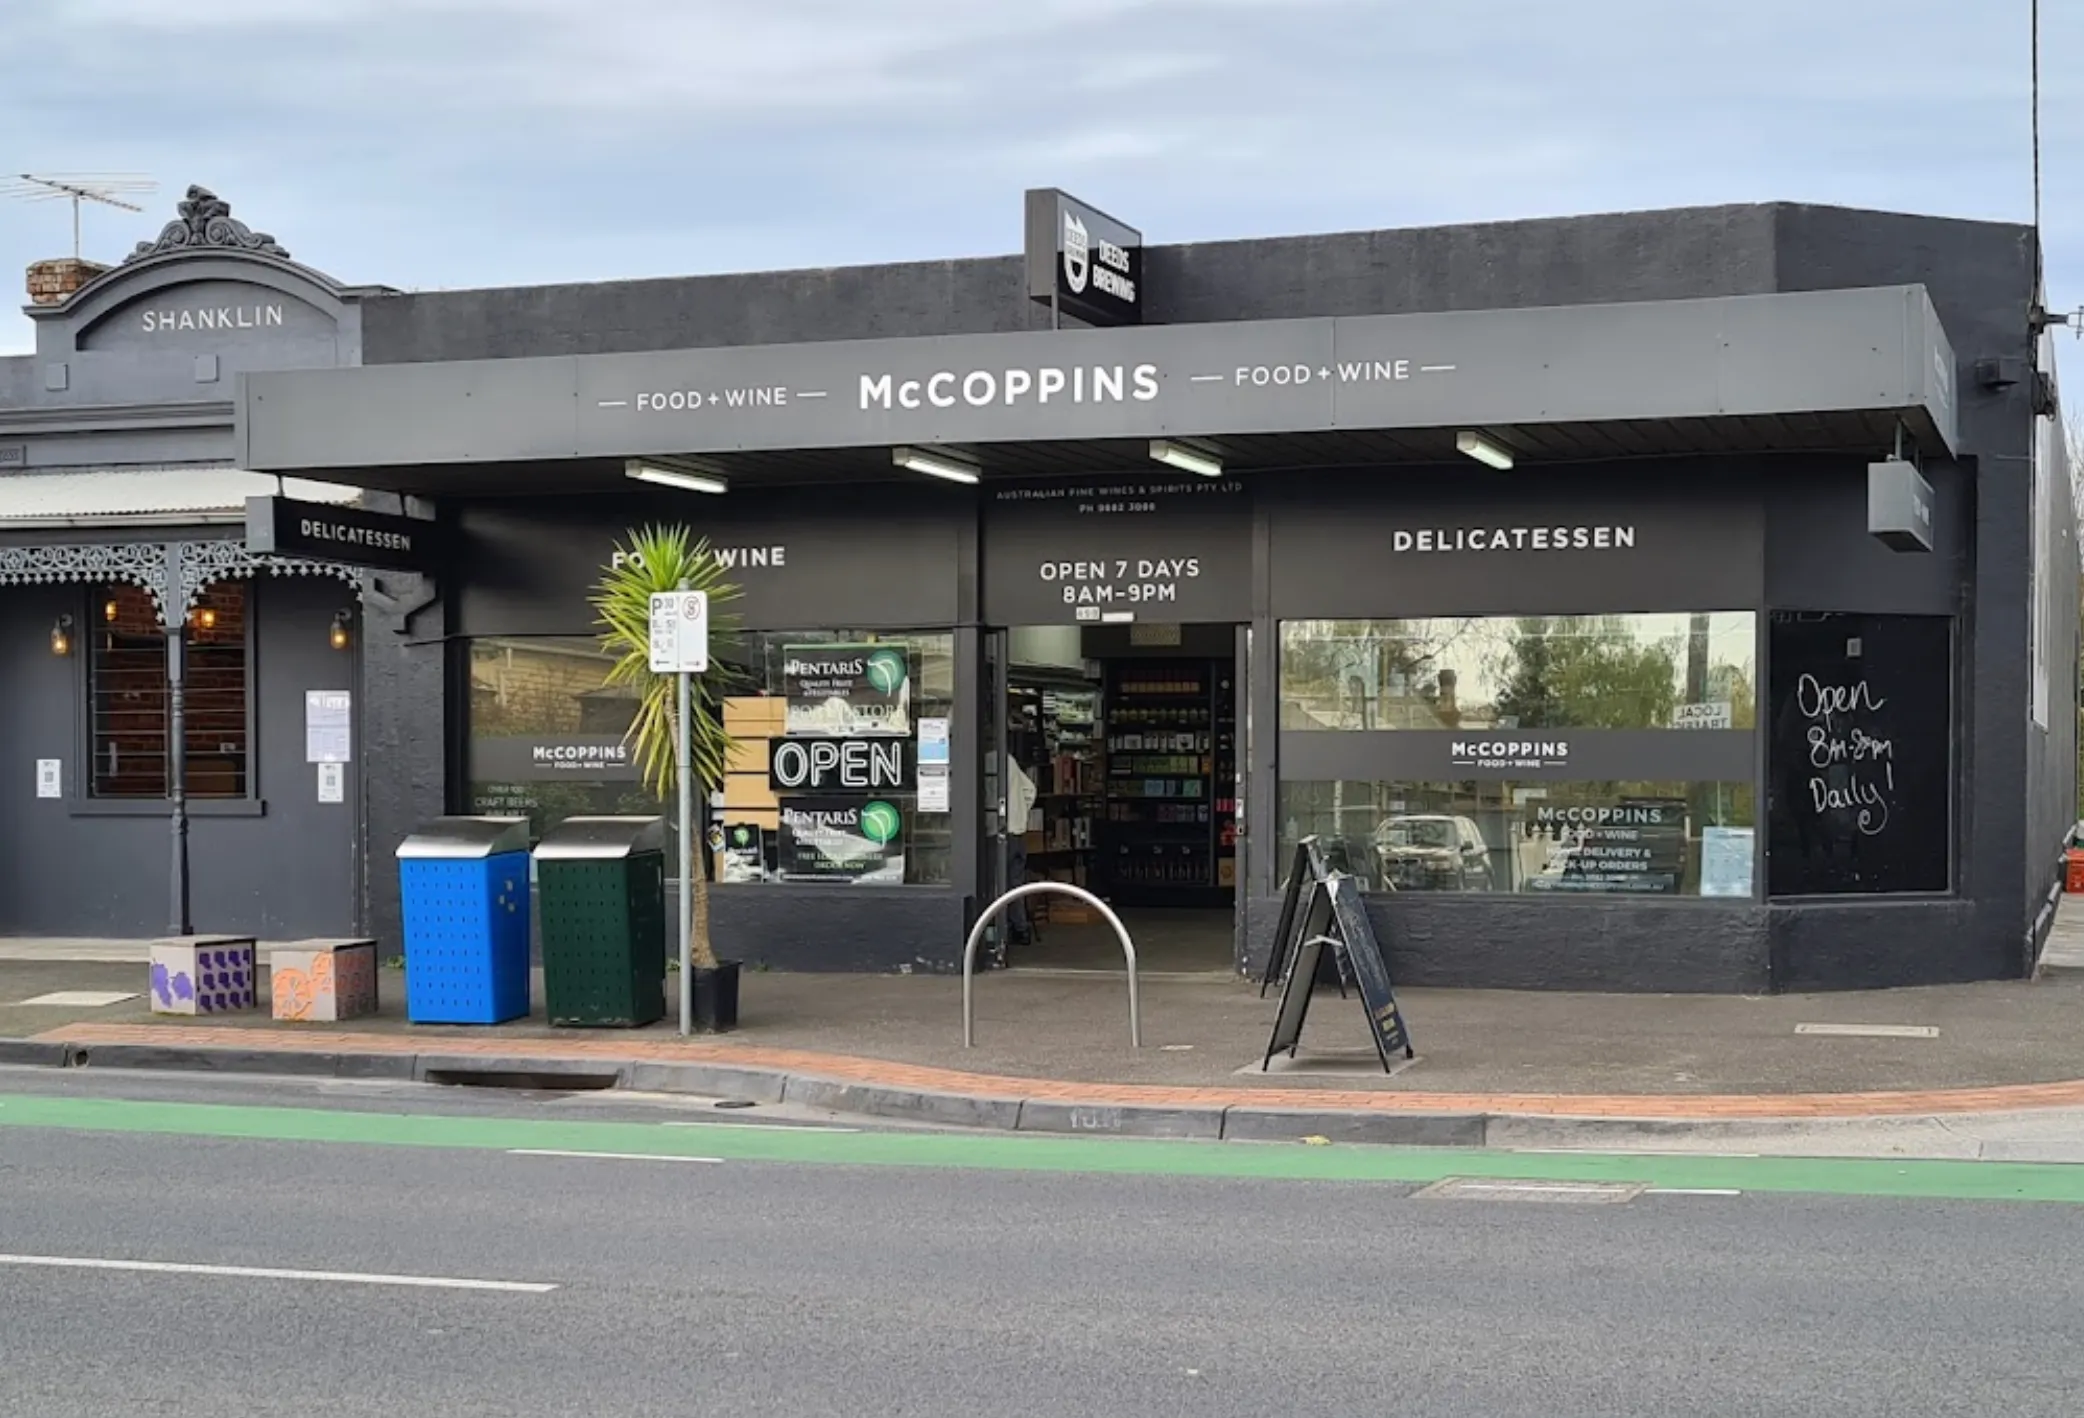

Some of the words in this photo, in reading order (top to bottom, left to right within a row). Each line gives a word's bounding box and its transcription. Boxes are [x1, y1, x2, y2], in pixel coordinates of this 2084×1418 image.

[1099, 239, 1130, 273] DEEDS
[1093, 264, 1137, 304] BREWING
[141, 304, 283, 333] SHANKLIN
[1235, 365, 1311, 386] FOOD
[1337, 360, 1410, 382] WINE
[859, 363, 1160, 410] McCOPPINS
[636, 392, 703, 411] FOOD
[725, 387, 788, 407] WINE
[996, 487, 1066, 500] AUSTRALIAN
[1069, 486, 1095, 498] FINE
[1098, 485, 1135, 497] WINES
[1150, 483, 1193, 495] SPIRITS
[1196, 482, 1218, 494] PTY
[1221, 481, 1243, 493] LTD
[300, 518, 412, 552] DELICATESSEN
[1393, 526, 1636, 552] DELICATESSEN
[714, 545, 786, 570] WINE
[1040, 560, 1105, 581] OPEN
[1115, 560, 1128, 579] 7
[1138, 558, 1200, 579] DAYS
[1062, 583, 1176, 604] 8AM-9PM
[652, 598, 663, 616] P
[1797, 673, 1888, 733] Open
[532, 745, 627, 760] McCOPPINS
[1451, 741, 1569, 757] McCOPPINS
[774, 741, 902, 788] OPEN
[474, 796, 505, 808] CRAFT
[506, 796, 538, 809] BEERS
[1537, 806, 1663, 823] McCOPPINS
[1604, 829, 1640, 841] WINE
[1582, 846, 1640, 859] DELIVERY
[1598, 860, 1649, 872] ORDERS
